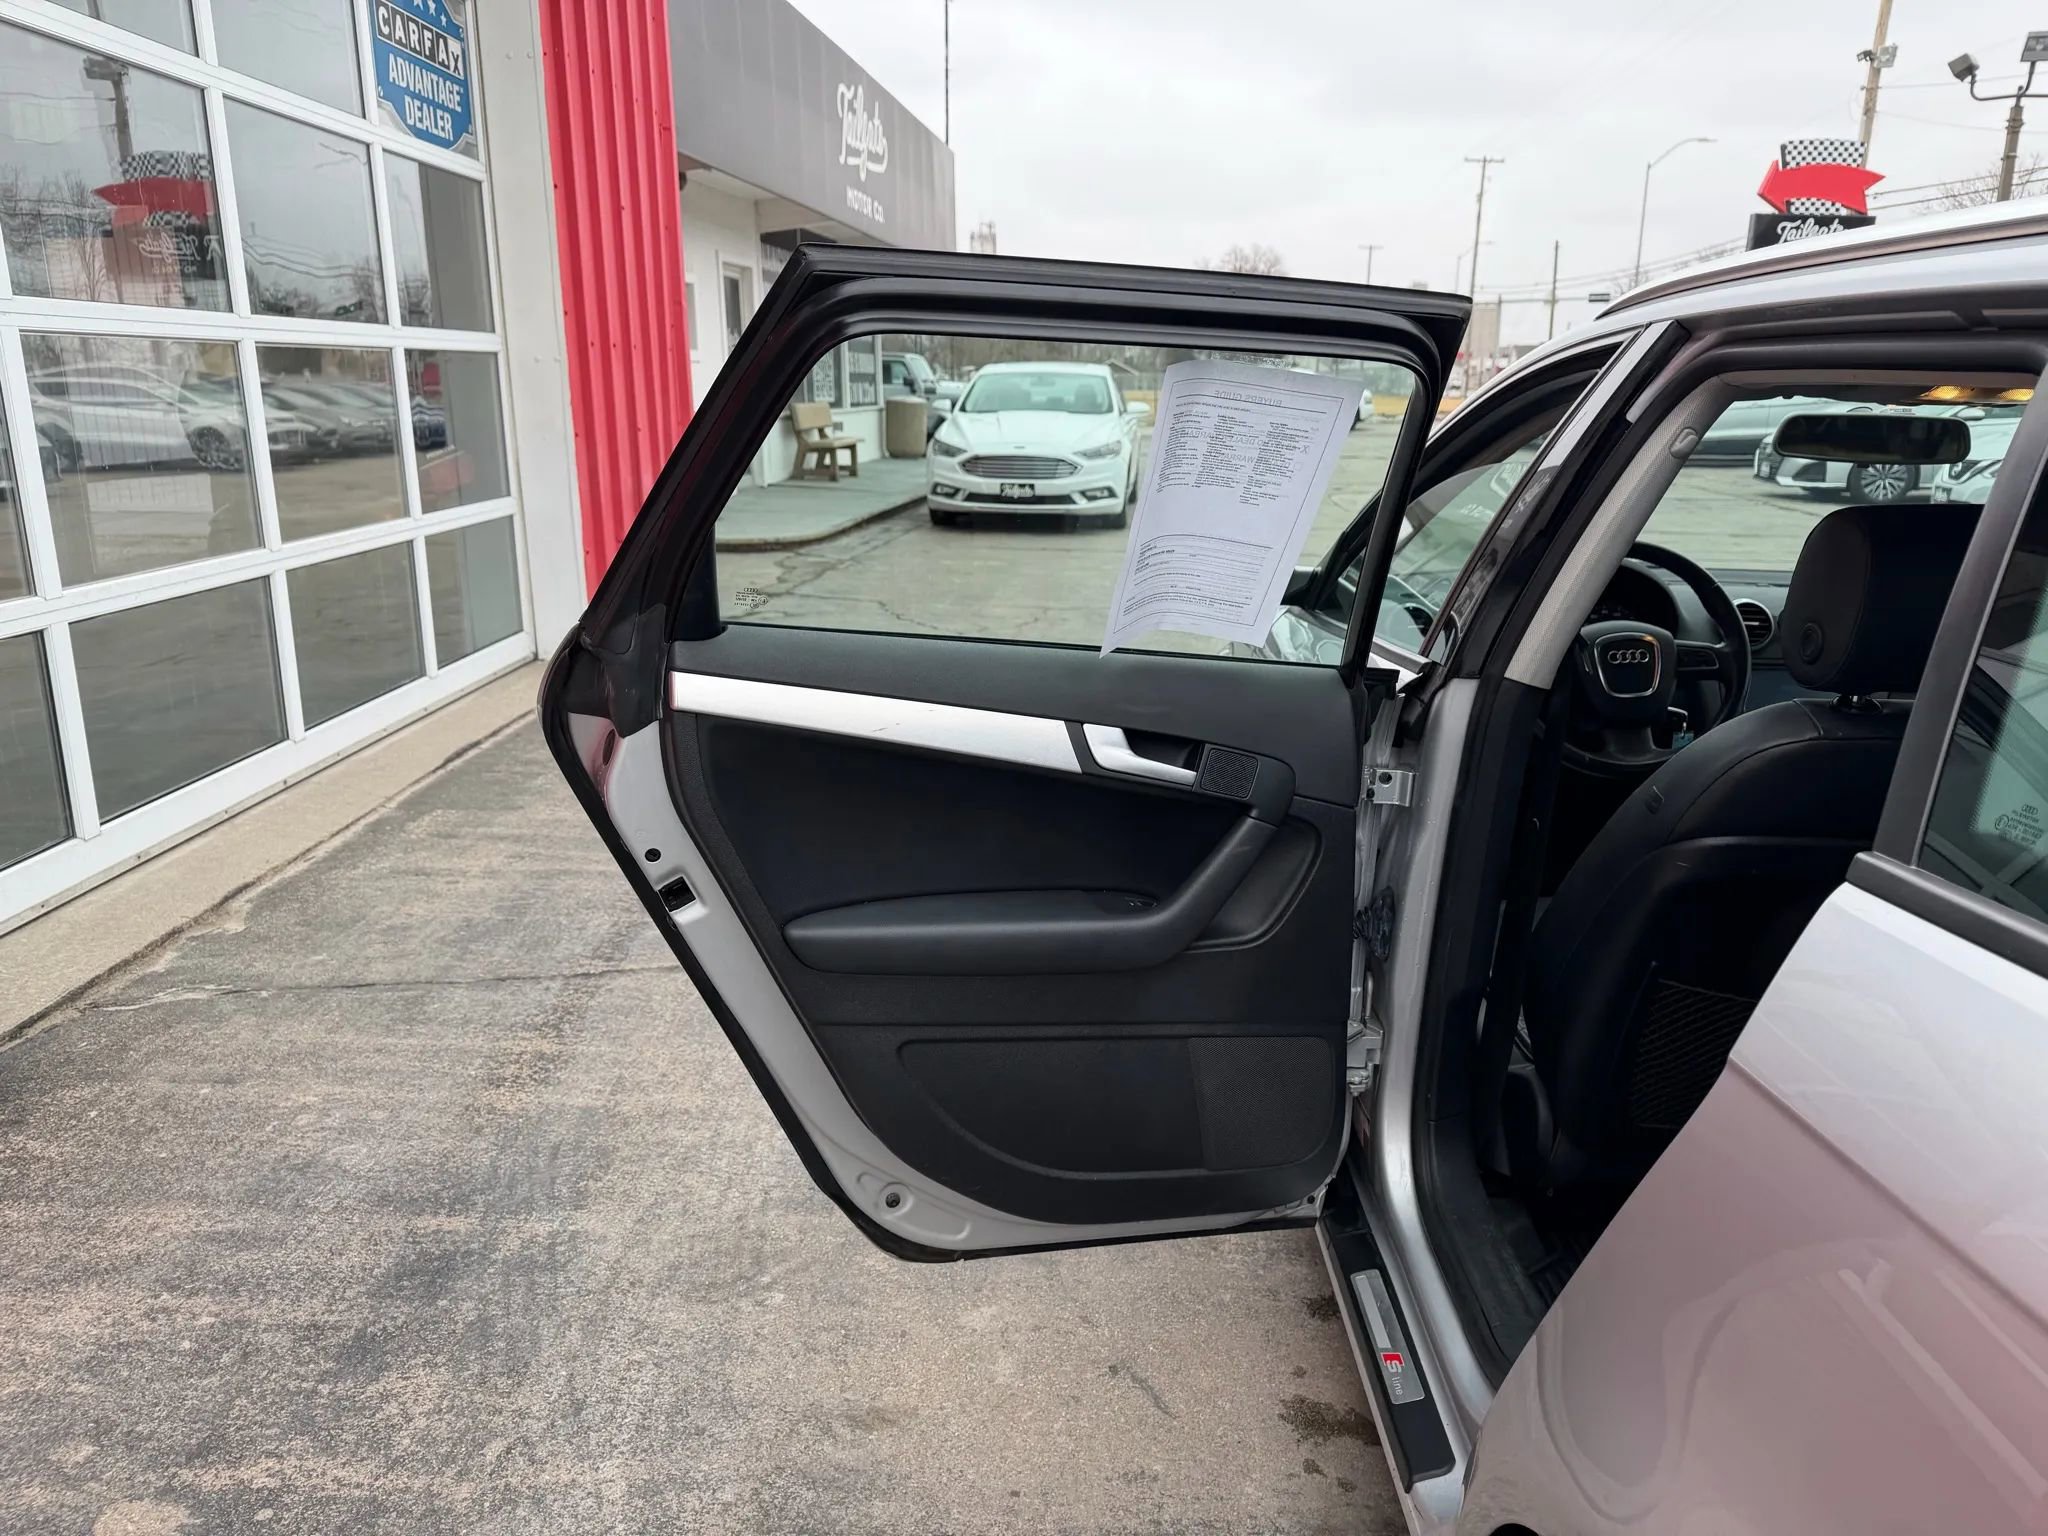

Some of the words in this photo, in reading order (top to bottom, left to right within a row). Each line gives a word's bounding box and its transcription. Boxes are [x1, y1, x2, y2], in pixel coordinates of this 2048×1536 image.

[378, 6, 462, 76] CARFAX
[389, 53, 462, 112] ADVANTAGE
[404, 95, 453, 141] DEALER
[847, 185, 872, 218] MOTOR
[1391, 1376, 1403, 1395] line
